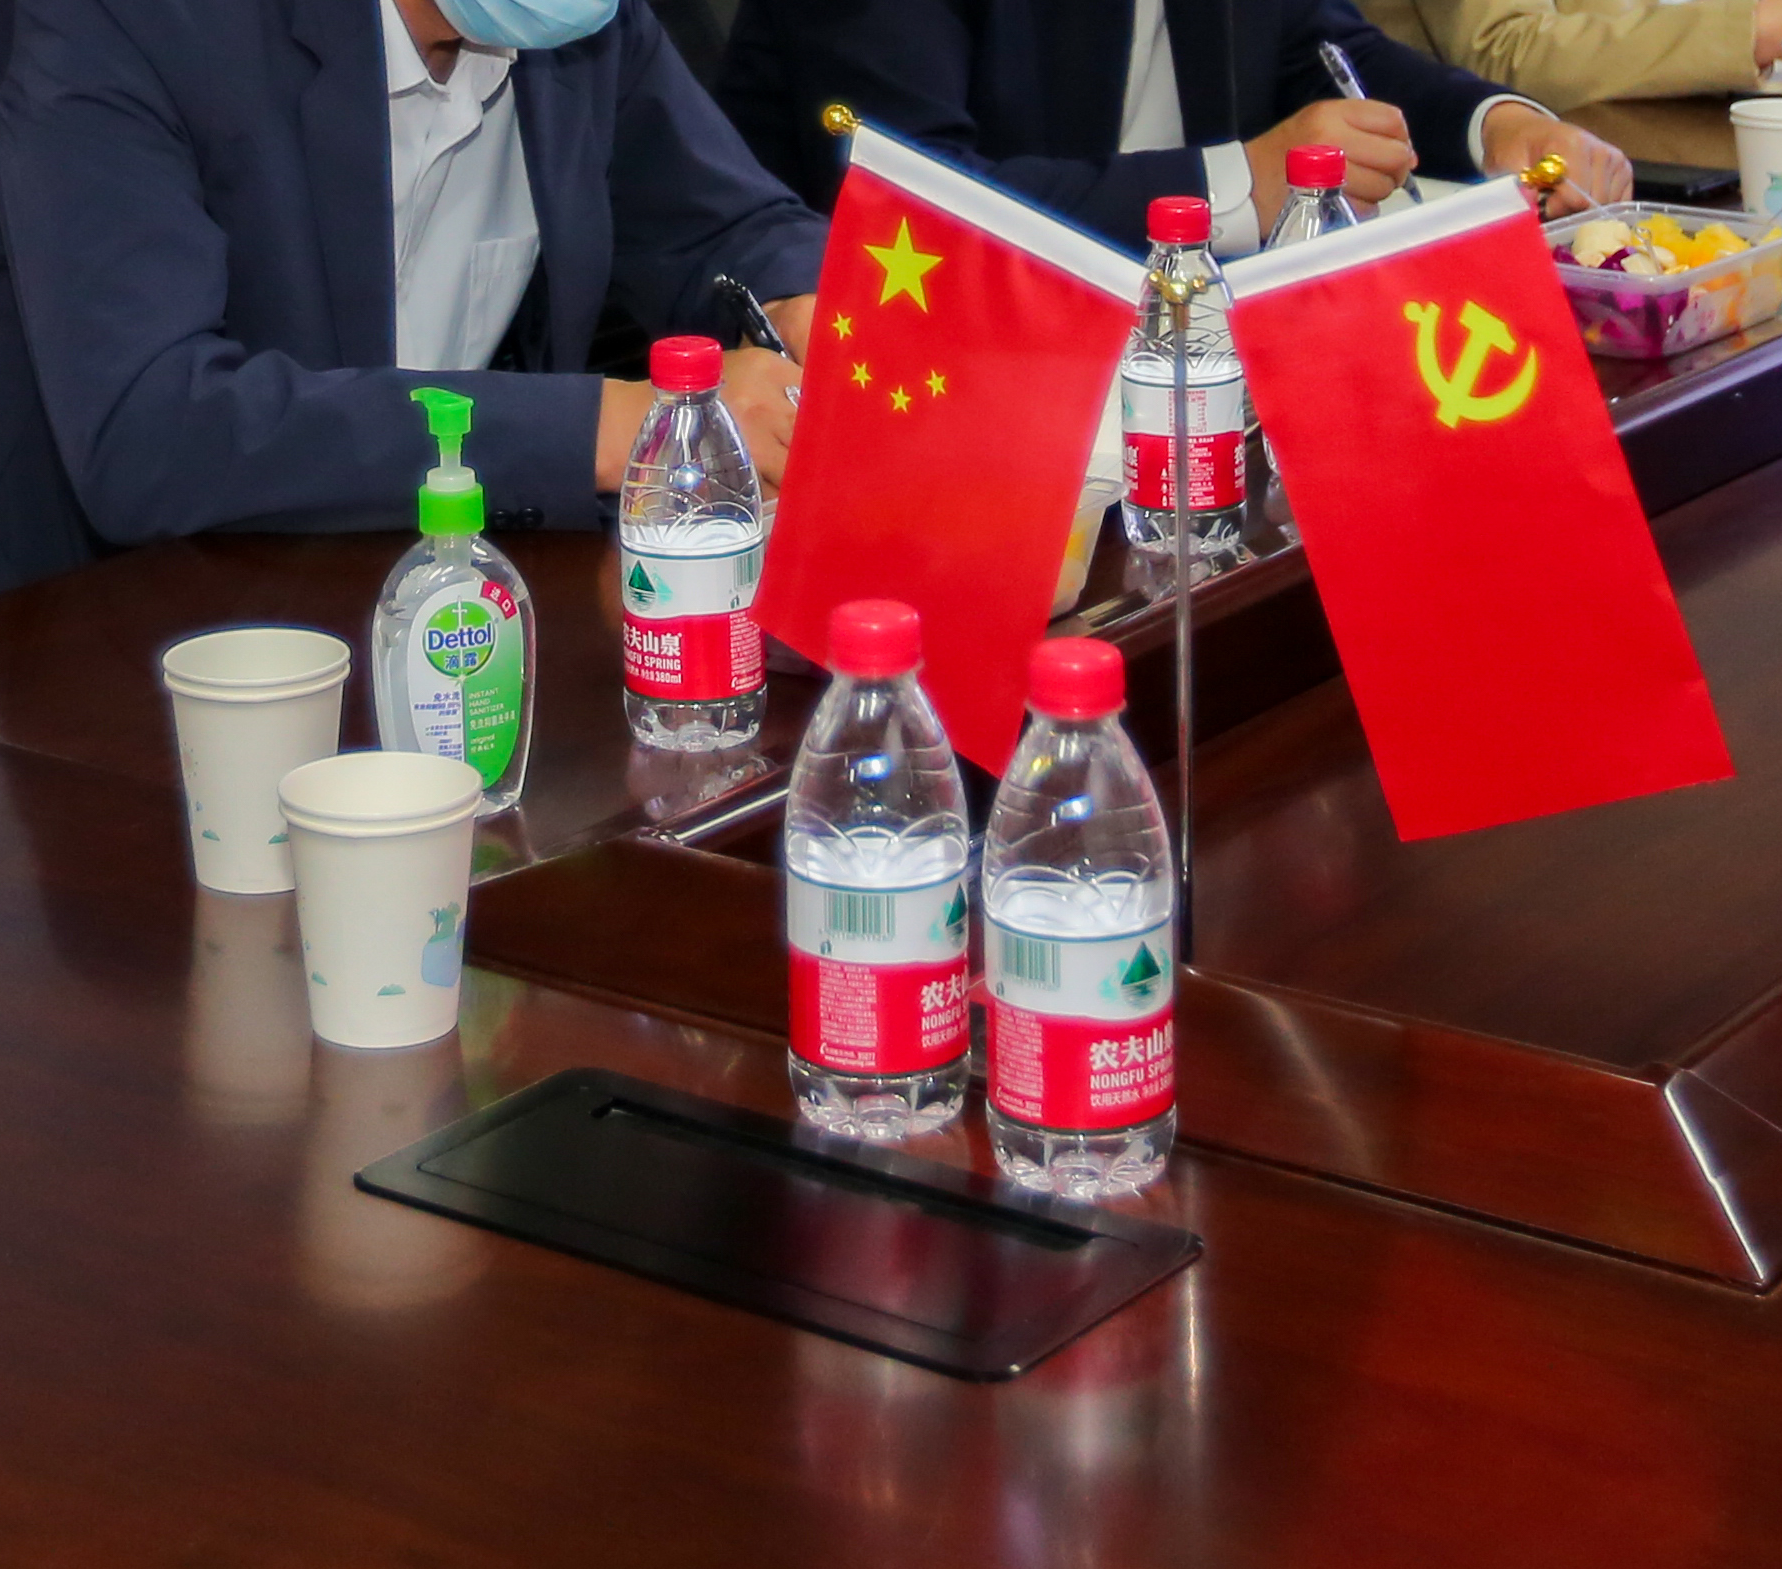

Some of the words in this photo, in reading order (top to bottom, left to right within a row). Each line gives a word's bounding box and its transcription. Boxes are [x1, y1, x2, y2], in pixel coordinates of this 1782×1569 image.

[427, 622, 492, 651] Dettol
[444, 651, 478, 670] 滴露
[644, 655, 682, 671] SPRING
[467, 687, 499, 700] INSTANT
[468, 698, 491, 708] HAND
[468, 703, 505, 717] SANITIZER
[1089, 1067, 1145, 1090] NONGFU
